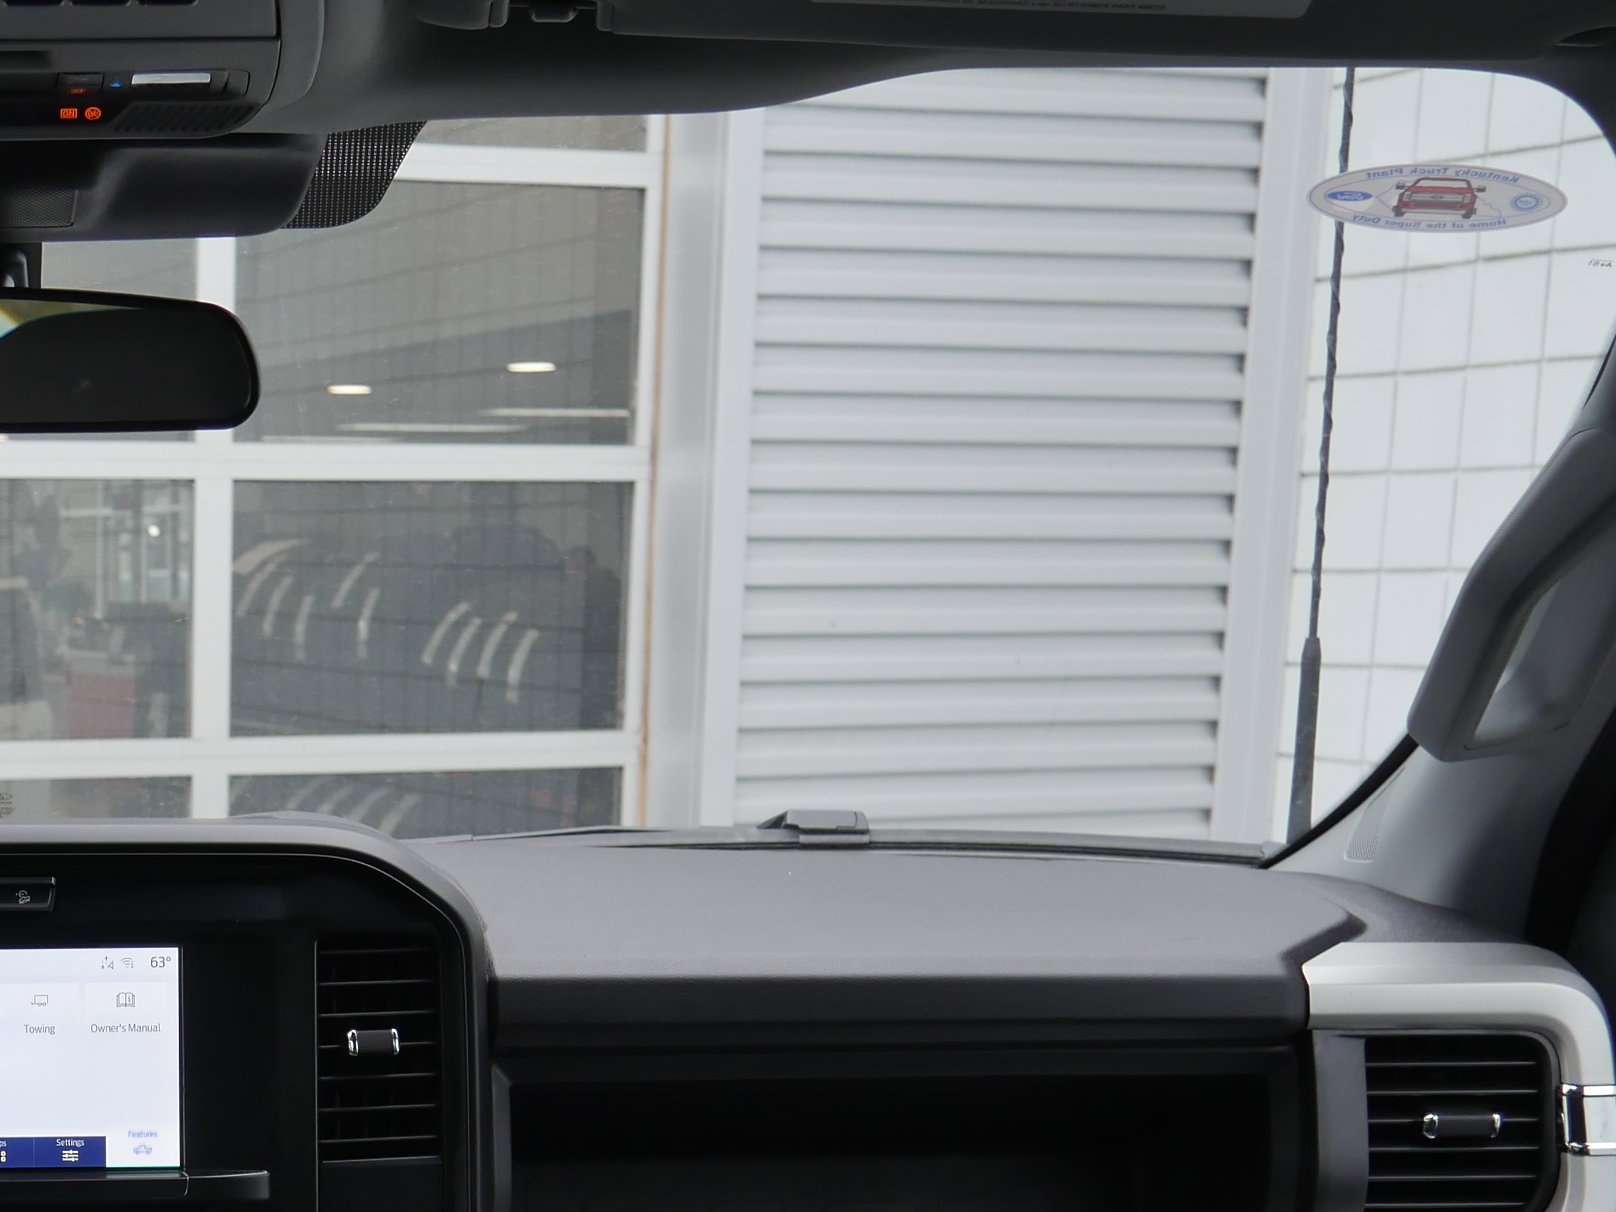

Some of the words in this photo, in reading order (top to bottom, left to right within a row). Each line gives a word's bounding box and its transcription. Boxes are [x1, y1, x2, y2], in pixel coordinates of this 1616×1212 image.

[150, 956, 172, 968] 63°
[24, 1024, 56, 1036] Towing
[90, 1023, 126, 1033] Owner's
[128, 1022, 161, 1032] Manual
[128, 1130, 158, 1138] Features
[56, 1138, 85, 1148] Settings
